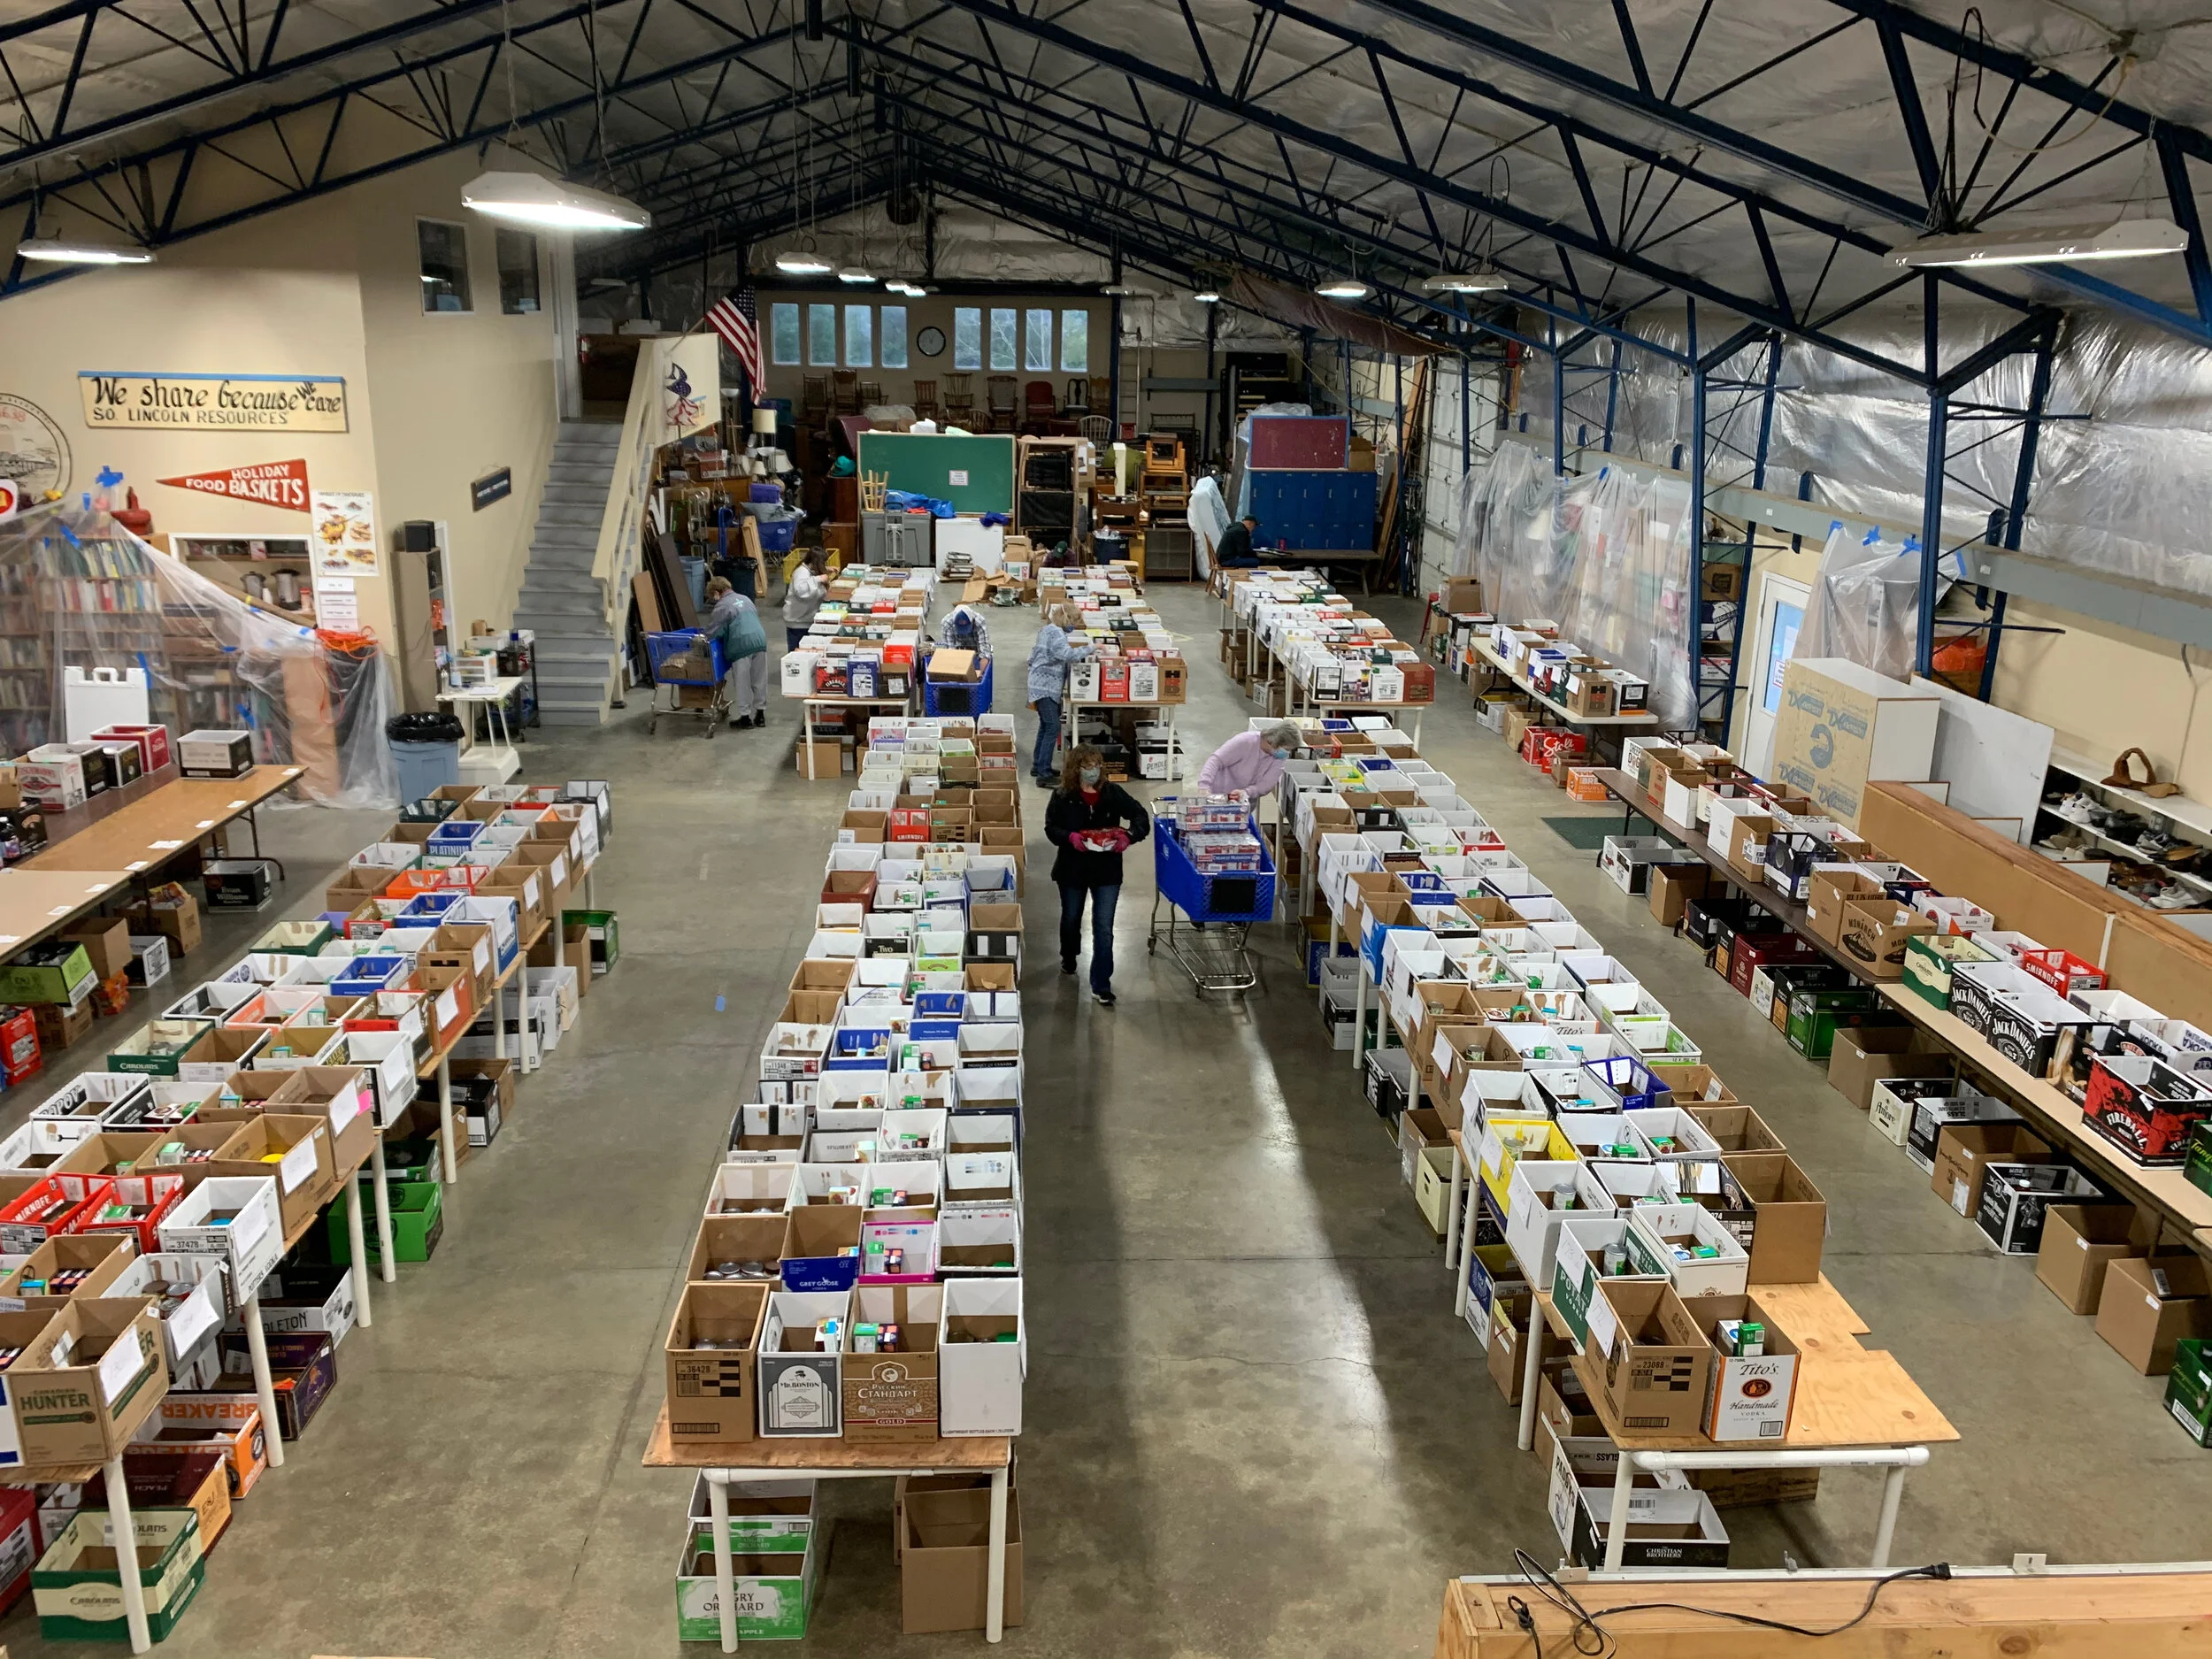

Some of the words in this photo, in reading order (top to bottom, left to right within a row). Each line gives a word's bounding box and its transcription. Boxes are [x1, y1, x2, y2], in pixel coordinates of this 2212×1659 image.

[91, 377, 127, 405] We
[140, 379, 208, 407] share
[218, 380, 297, 411] because
[305, 396, 342, 413] care
[128, 409, 189, 423] LINCOLN
[196, 411, 288, 425] RESOURCES
[231, 465, 289, 480] HOLIDAY
[186, 479, 227, 492] FOOD
[229, 479, 304, 505] BASKETS
[429, 844, 469, 856] PLATINUM
[1848, 918, 1876, 942] MONARCH
[2025, 962, 2059, 987] SMIRNOFF
[1951, 987, 1969, 1003] JACK
[1967, 988, 1992, 1024] DANIEL'S
[1992, 1019, 2012, 1037] JACK
[2010, 1021, 2036, 1060] DANIEL'S
[2106, 1112, 2148, 1150] FIREBALL
[820, 1279, 839, 1287] GOOSE
[1740, 1363, 1778, 1376] Tito's
[19, 1393, 90, 1410] HUNTER
[1729, 1400, 1779, 1410] Handmade
[712, 1593, 754, 1602] AGRY
[703, 1602, 764, 1611] ORARD
